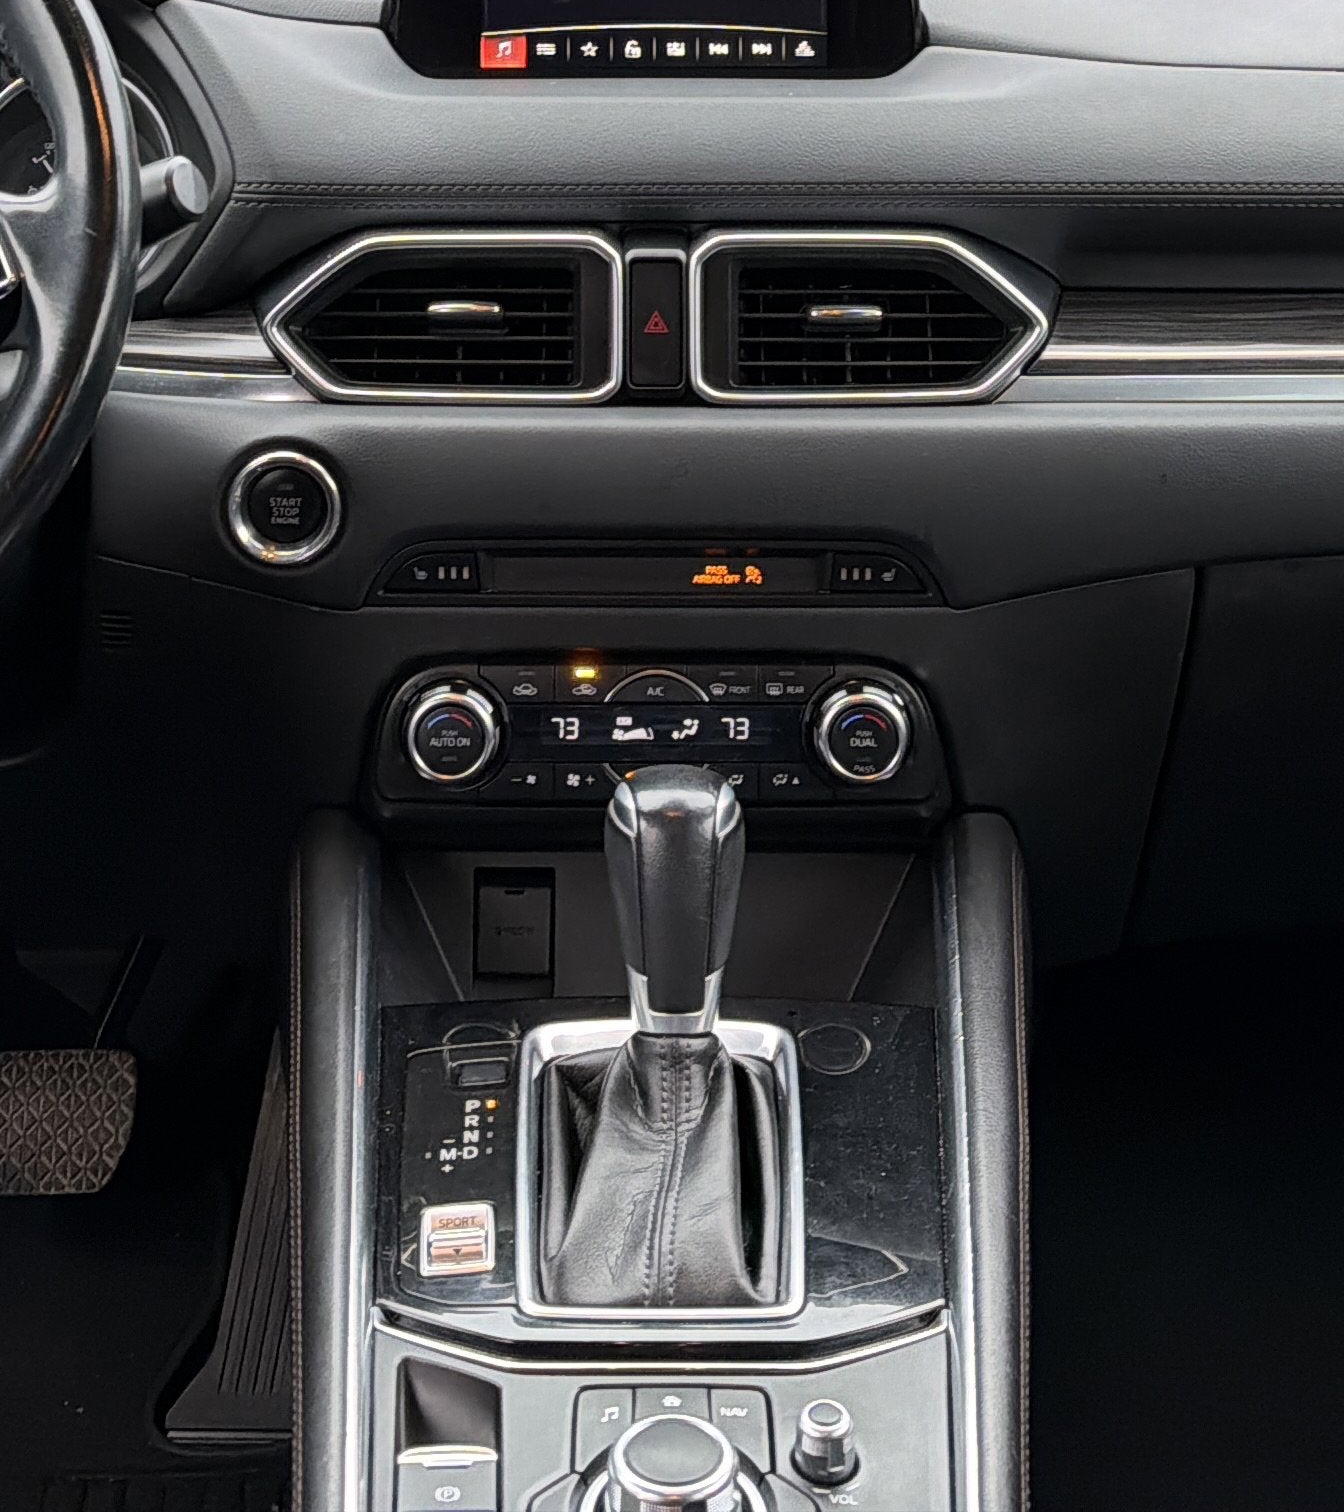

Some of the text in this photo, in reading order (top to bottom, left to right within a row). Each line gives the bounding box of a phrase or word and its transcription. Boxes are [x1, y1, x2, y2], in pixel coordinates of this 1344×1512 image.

[268, 496, 303, 507] START
[272, 507, 300, 517] STOP
[270, 516, 300, 525] ENGINE
[705, 565, 728, 575] PASS
[692, 574, 742, 585] AIRBAG OFF
[646, 686, 665, 697] A/C
[728, 686, 751, 695] FRONT
[786, 686, 805, 695] REAR
[550, 717, 580, 740] 73
[720, 717, 750, 740] 73
[429, 737, 471, 747] AUTO ON
[849, 737, 878, 748] DUAL
[853, 763, 876, 773] PASS
[464, 1099, 482, 1113] P
[464, 1114, 480, 1128] R
[462, 1129, 480, 1144] N
[438, 1215, 477, 1229] SPORT
[719, 1406, 749, 1418] NAV
[829, 1493, 859, 1506] VOL
